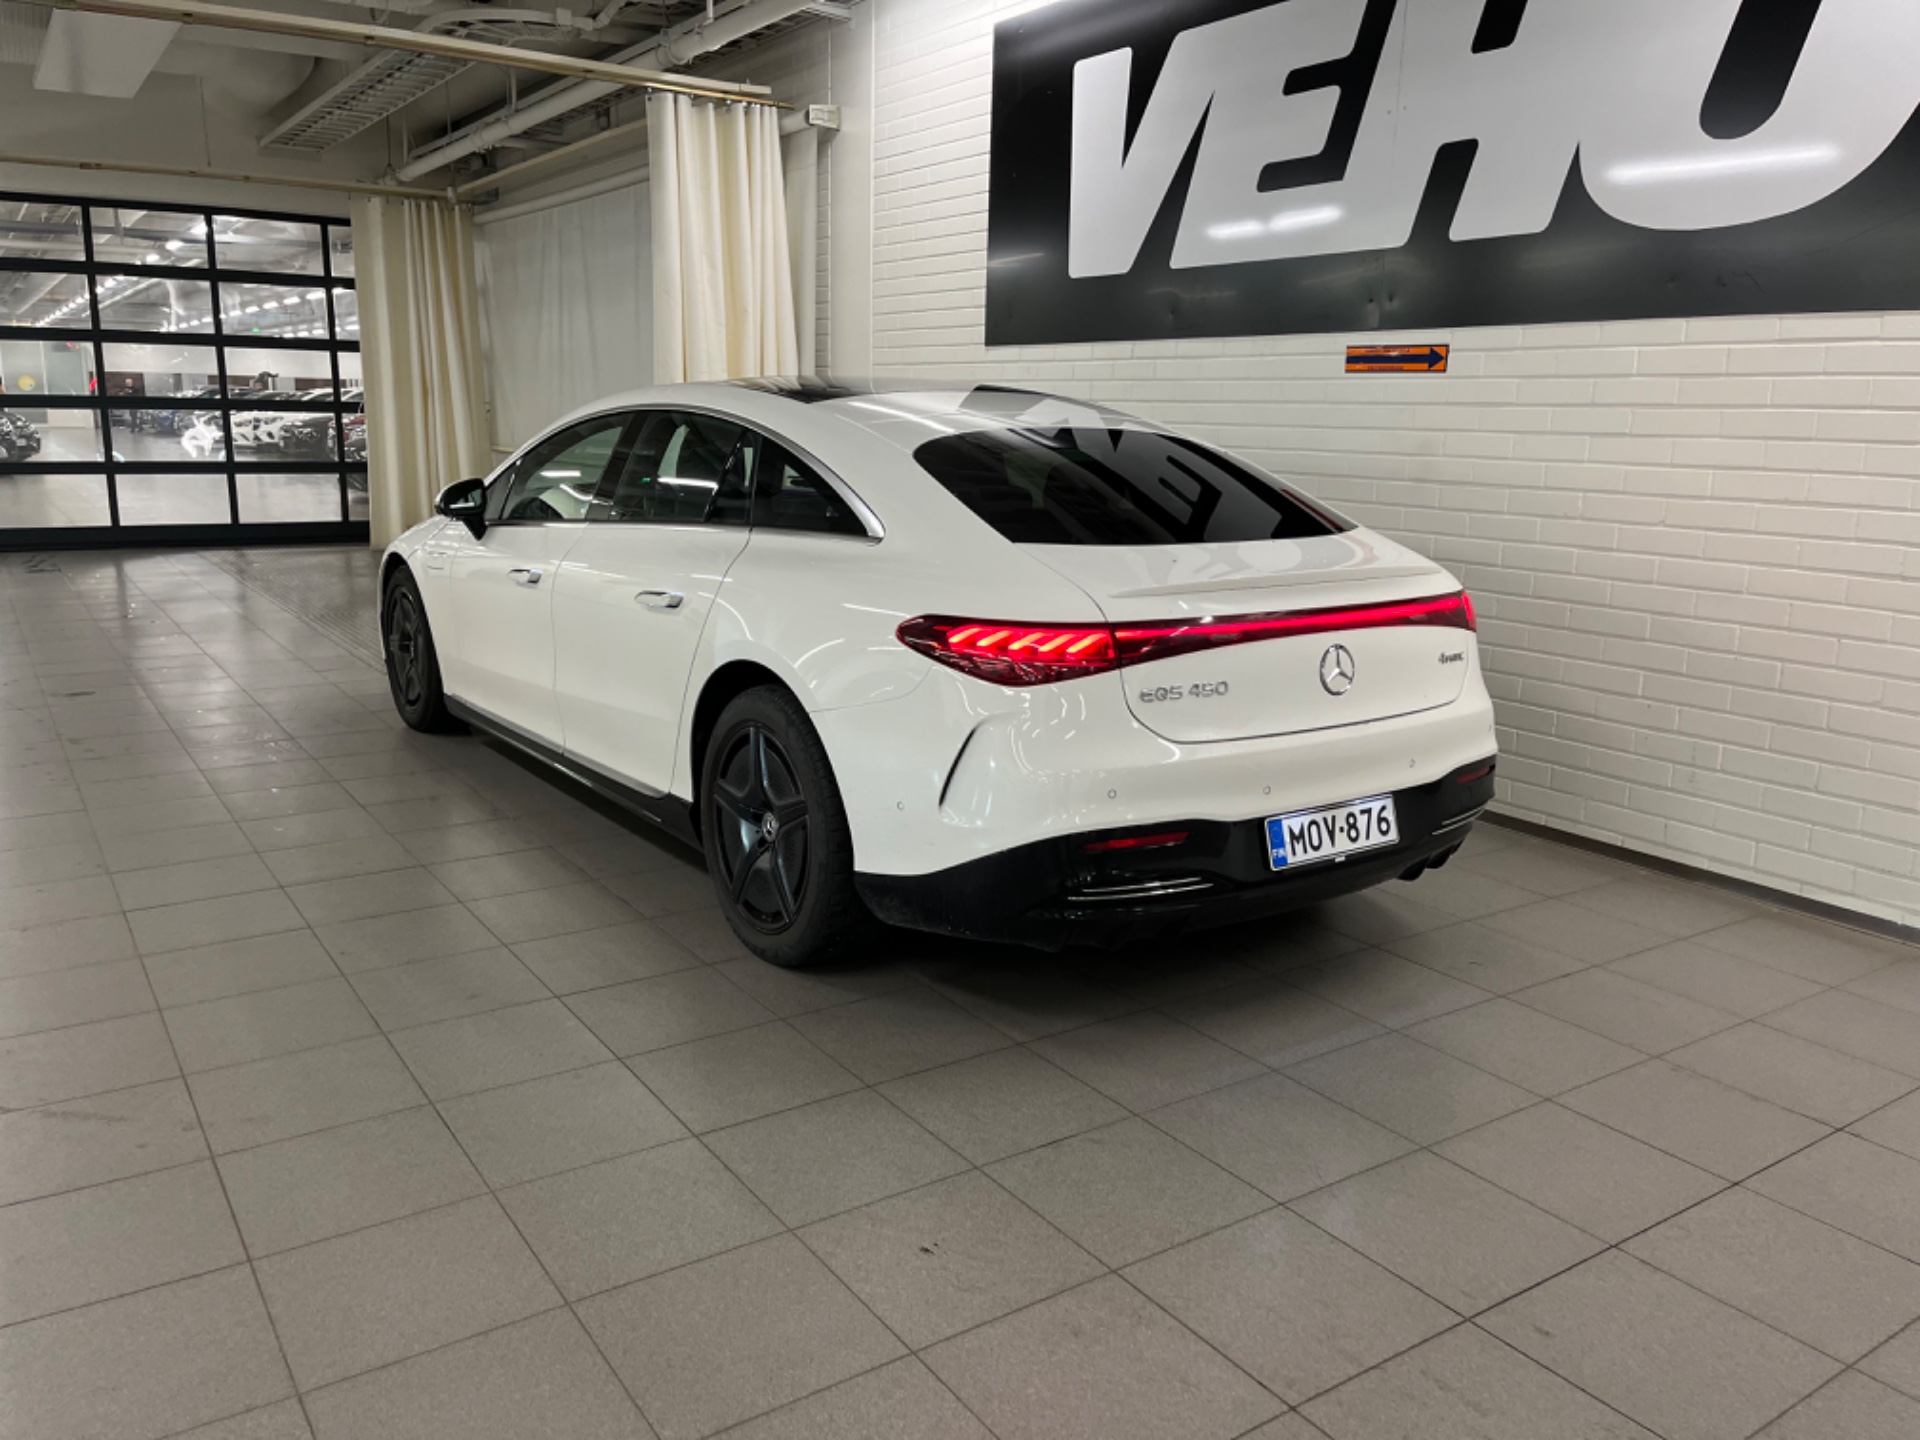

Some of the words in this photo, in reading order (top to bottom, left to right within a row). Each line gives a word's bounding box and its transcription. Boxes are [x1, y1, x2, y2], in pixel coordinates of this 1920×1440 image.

[1139, 685, 1183, 703] EQS
[1188, 681, 1229, 698] 450
[1287, 804, 1391, 857] MOV-876
